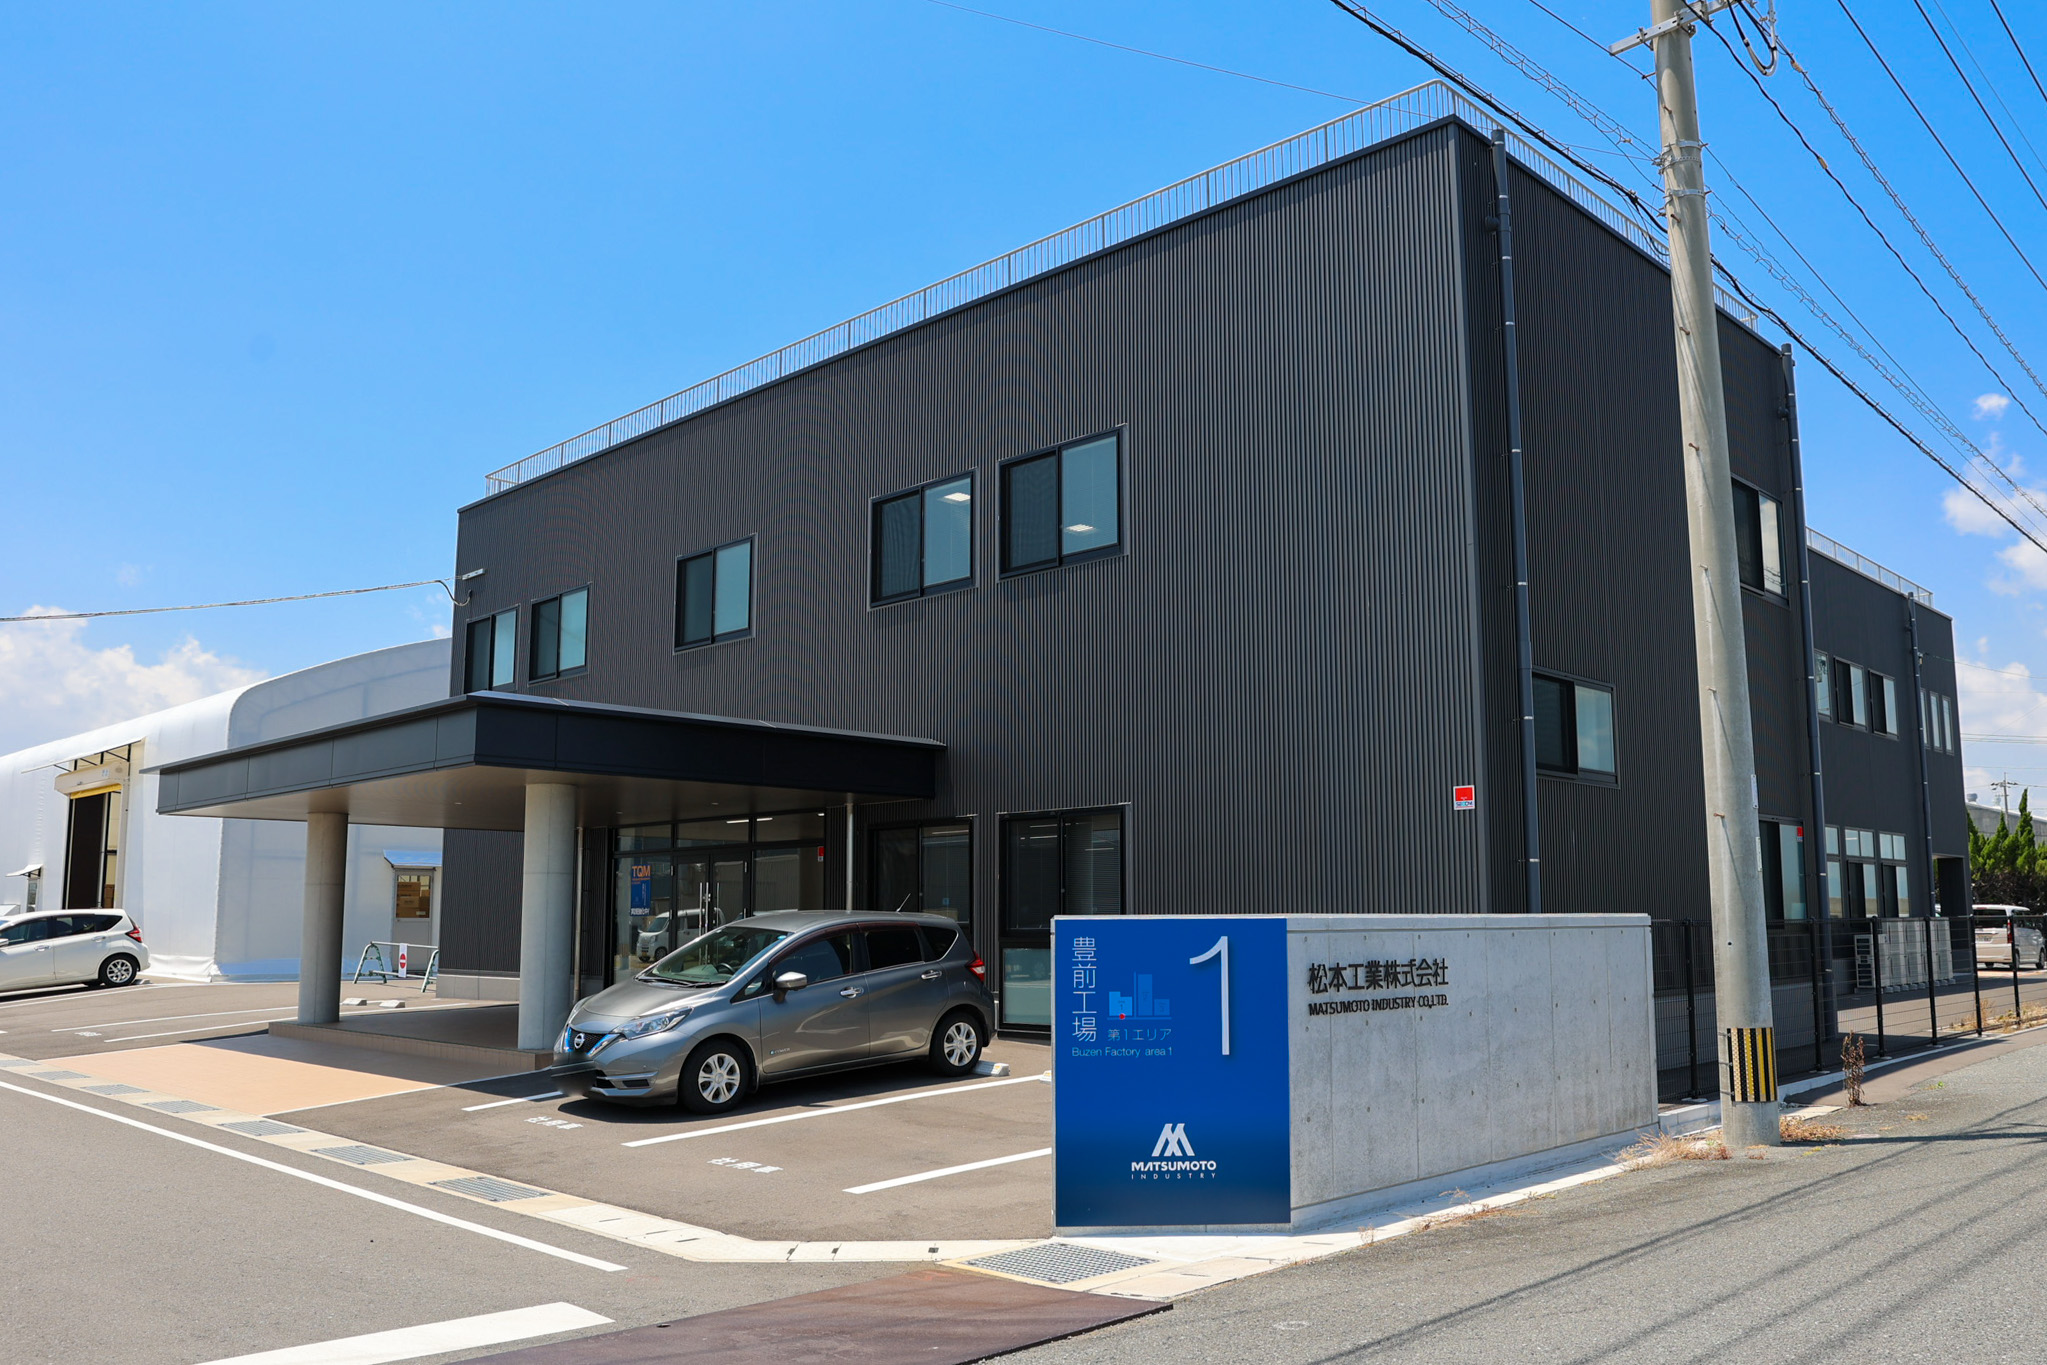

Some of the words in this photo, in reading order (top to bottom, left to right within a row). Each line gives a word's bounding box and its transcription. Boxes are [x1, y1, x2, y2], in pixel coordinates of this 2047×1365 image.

[632, 865, 650, 878] TQM
[1308, 957, 1449, 994] 松本工業株式会社
[1072, 937, 1097, 1042] 豊前工場
[1189, 936, 1230, 1056] 1
[1308, 998, 1370, 1016] MATSUMOTO
[1371, 996, 1416, 1011] INDUSTRY
[1072, 1047, 1102, 1057] Buzen
[1105, 1046, 1140, 1058] Factory
[1131, 1160, 1217, 1172] MATSUMOTO
[1131, 1172, 1216, 1180] INDUSTRY
